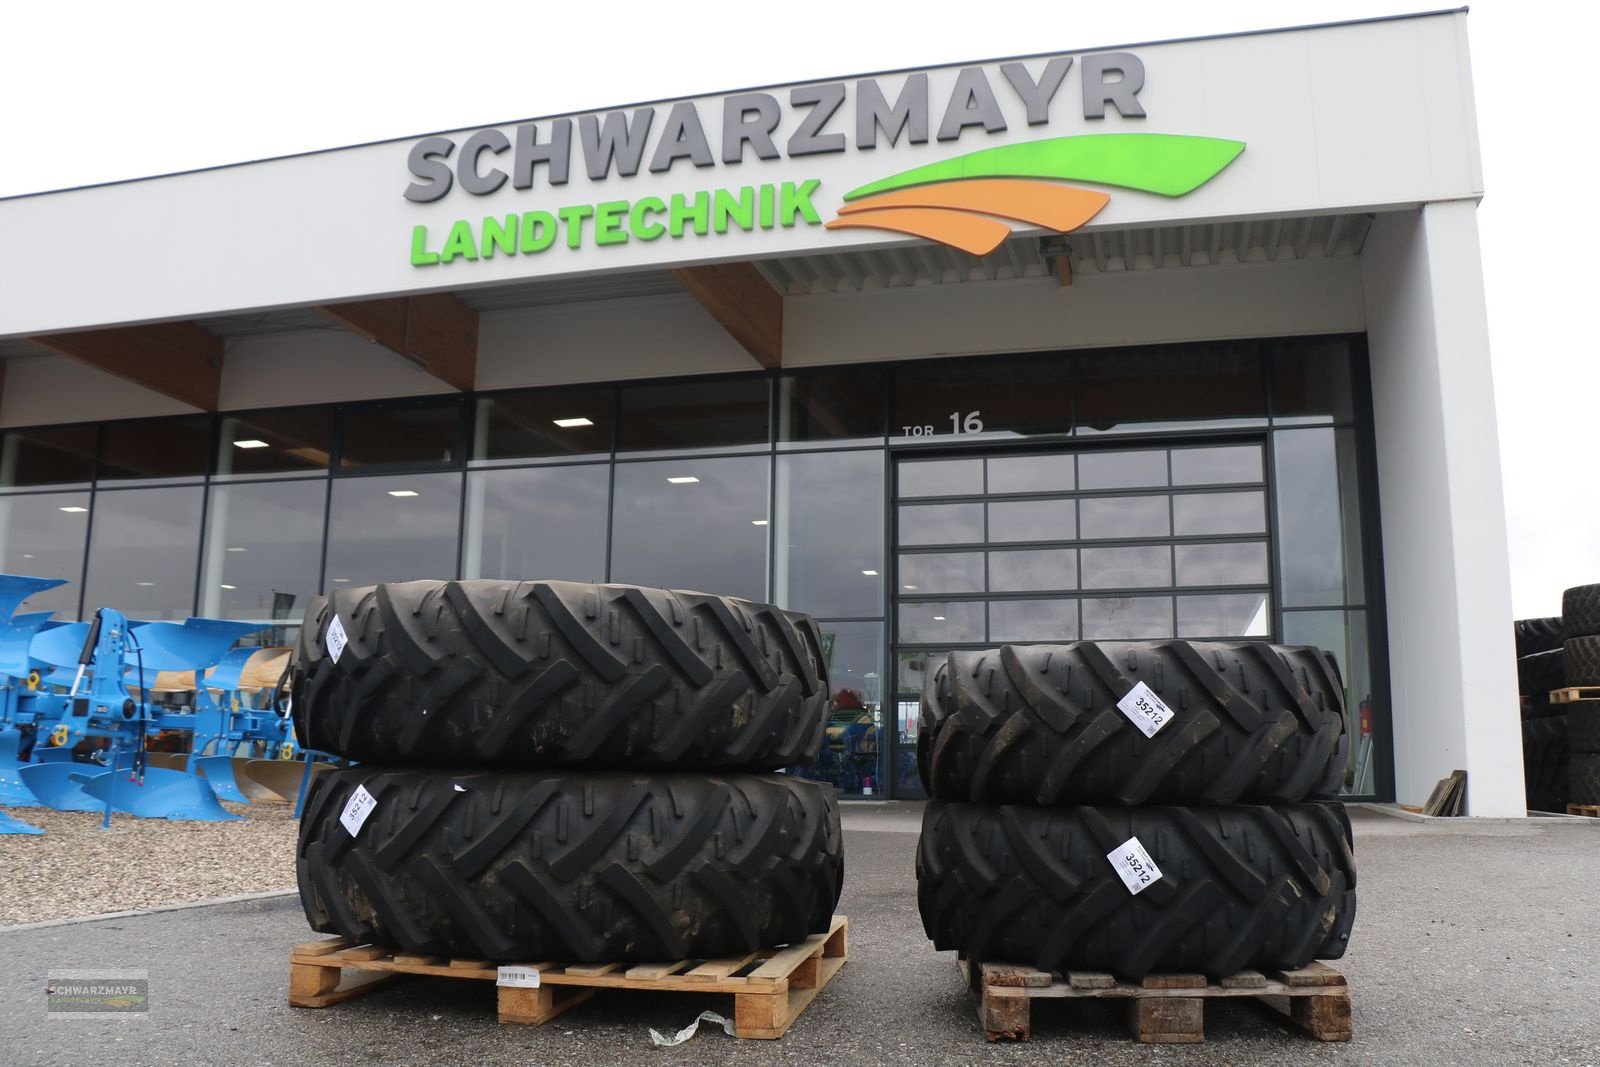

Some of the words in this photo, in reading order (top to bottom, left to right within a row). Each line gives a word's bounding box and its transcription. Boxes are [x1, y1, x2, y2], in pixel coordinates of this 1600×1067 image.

[403, 51, 1146, 203] SCHWARZMAYR
[411, 179, 821, 267] LANDTECHNIK
[902, 425, 934, 437] TOR
[949, 410, 984, 435] 16
[1135, 697, 1163, 725] 35212
[349, 793, 368, 821] 35212
[1125, 853, 1151, 884] 35212
